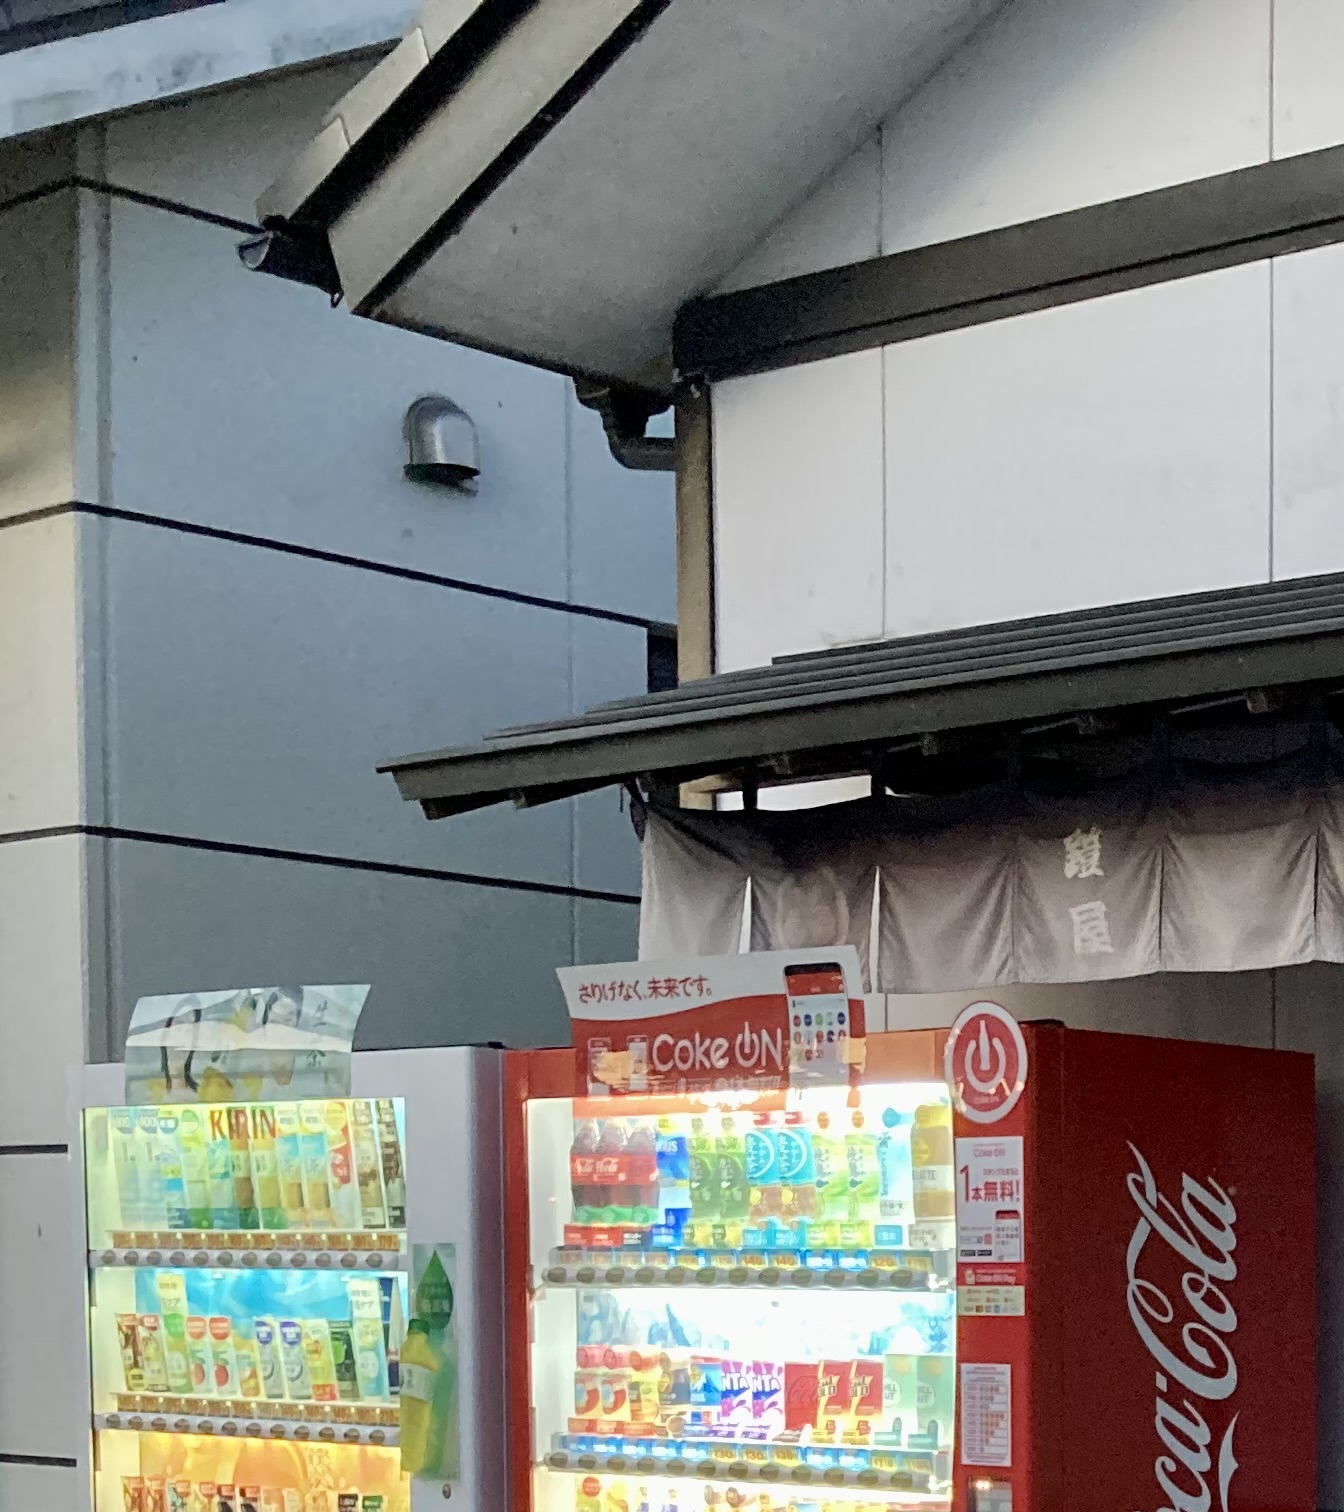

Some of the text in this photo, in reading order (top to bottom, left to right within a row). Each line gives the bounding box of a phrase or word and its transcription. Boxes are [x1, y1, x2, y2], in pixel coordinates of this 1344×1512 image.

[578, 974, 712, 1004] さりげなく、未来です。
[652, 1021, 784, 1072] Coke ON
[210, 1107, 278, 1143] KIRIN
[959, 1164, 1021, 1203] 1本無料!
